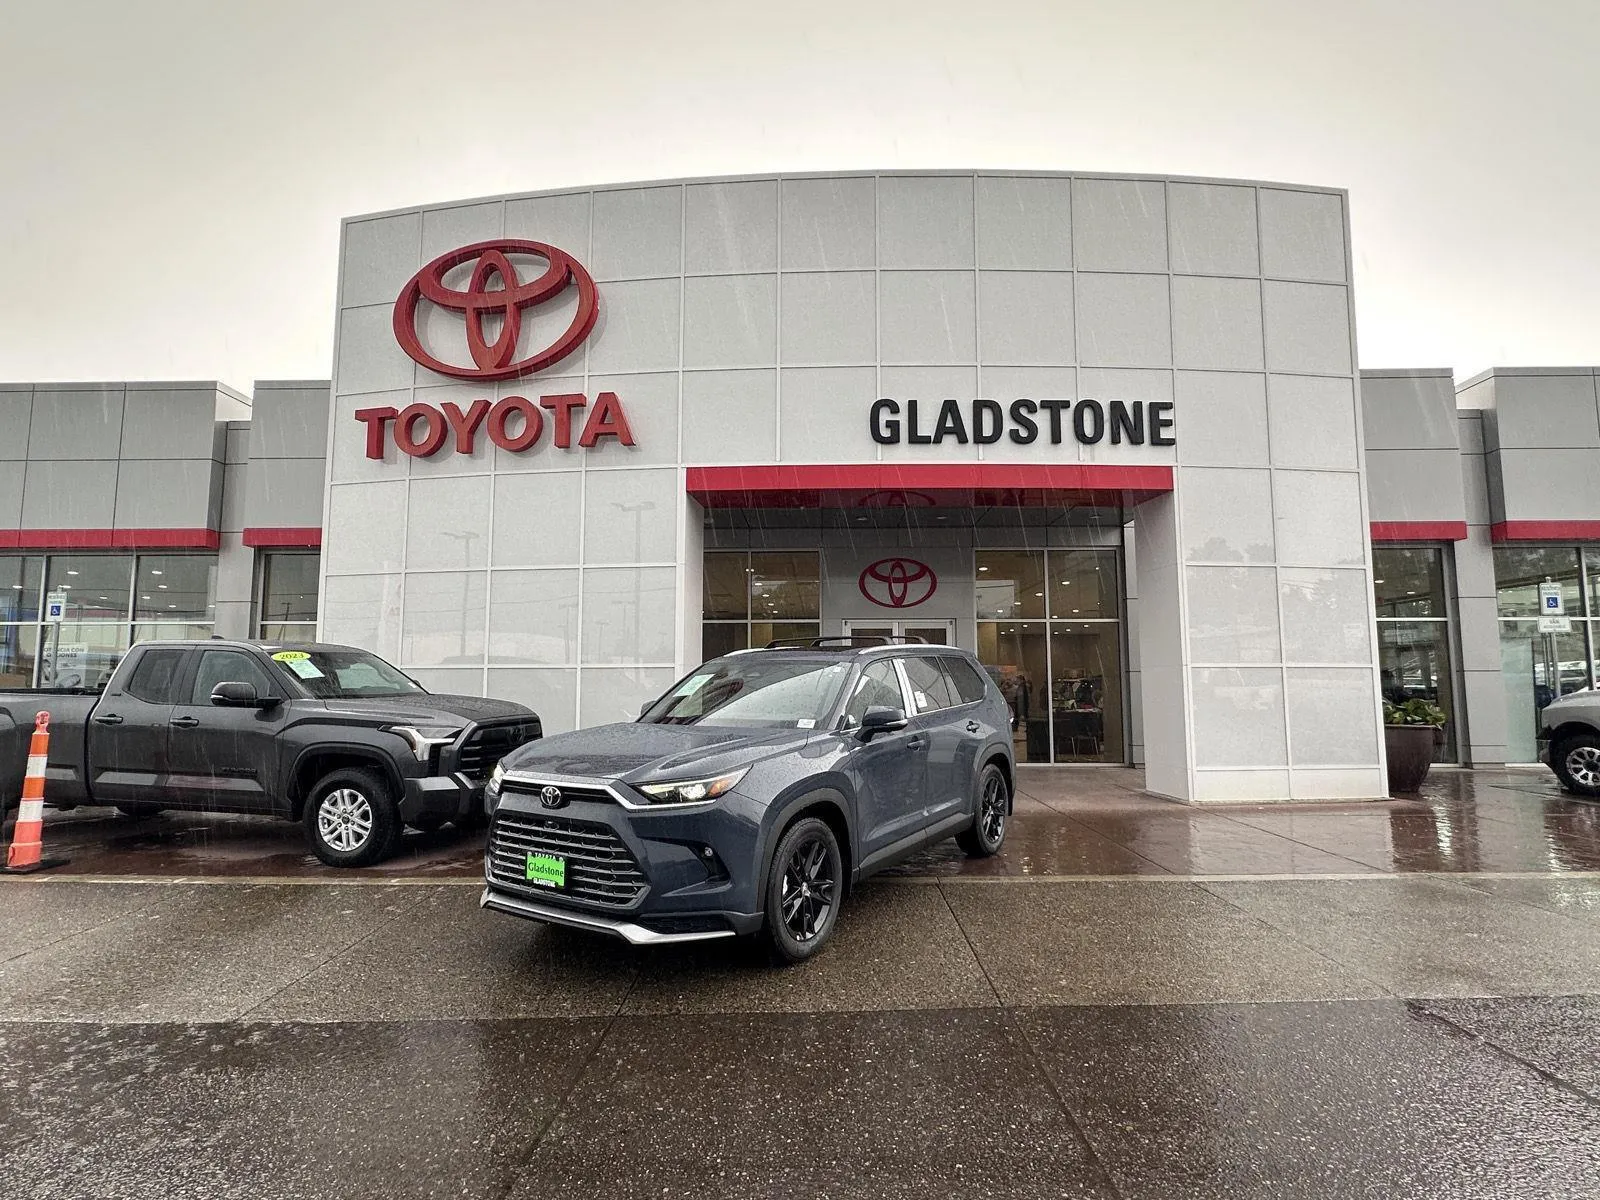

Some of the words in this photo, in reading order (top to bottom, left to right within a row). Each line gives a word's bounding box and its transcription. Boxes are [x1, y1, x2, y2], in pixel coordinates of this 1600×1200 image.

[354, 391, 636, 460] TOYOTA
[869, 398, 1176, 446] GLADSTONE
[528, 862, 564, 877] Gladstone
